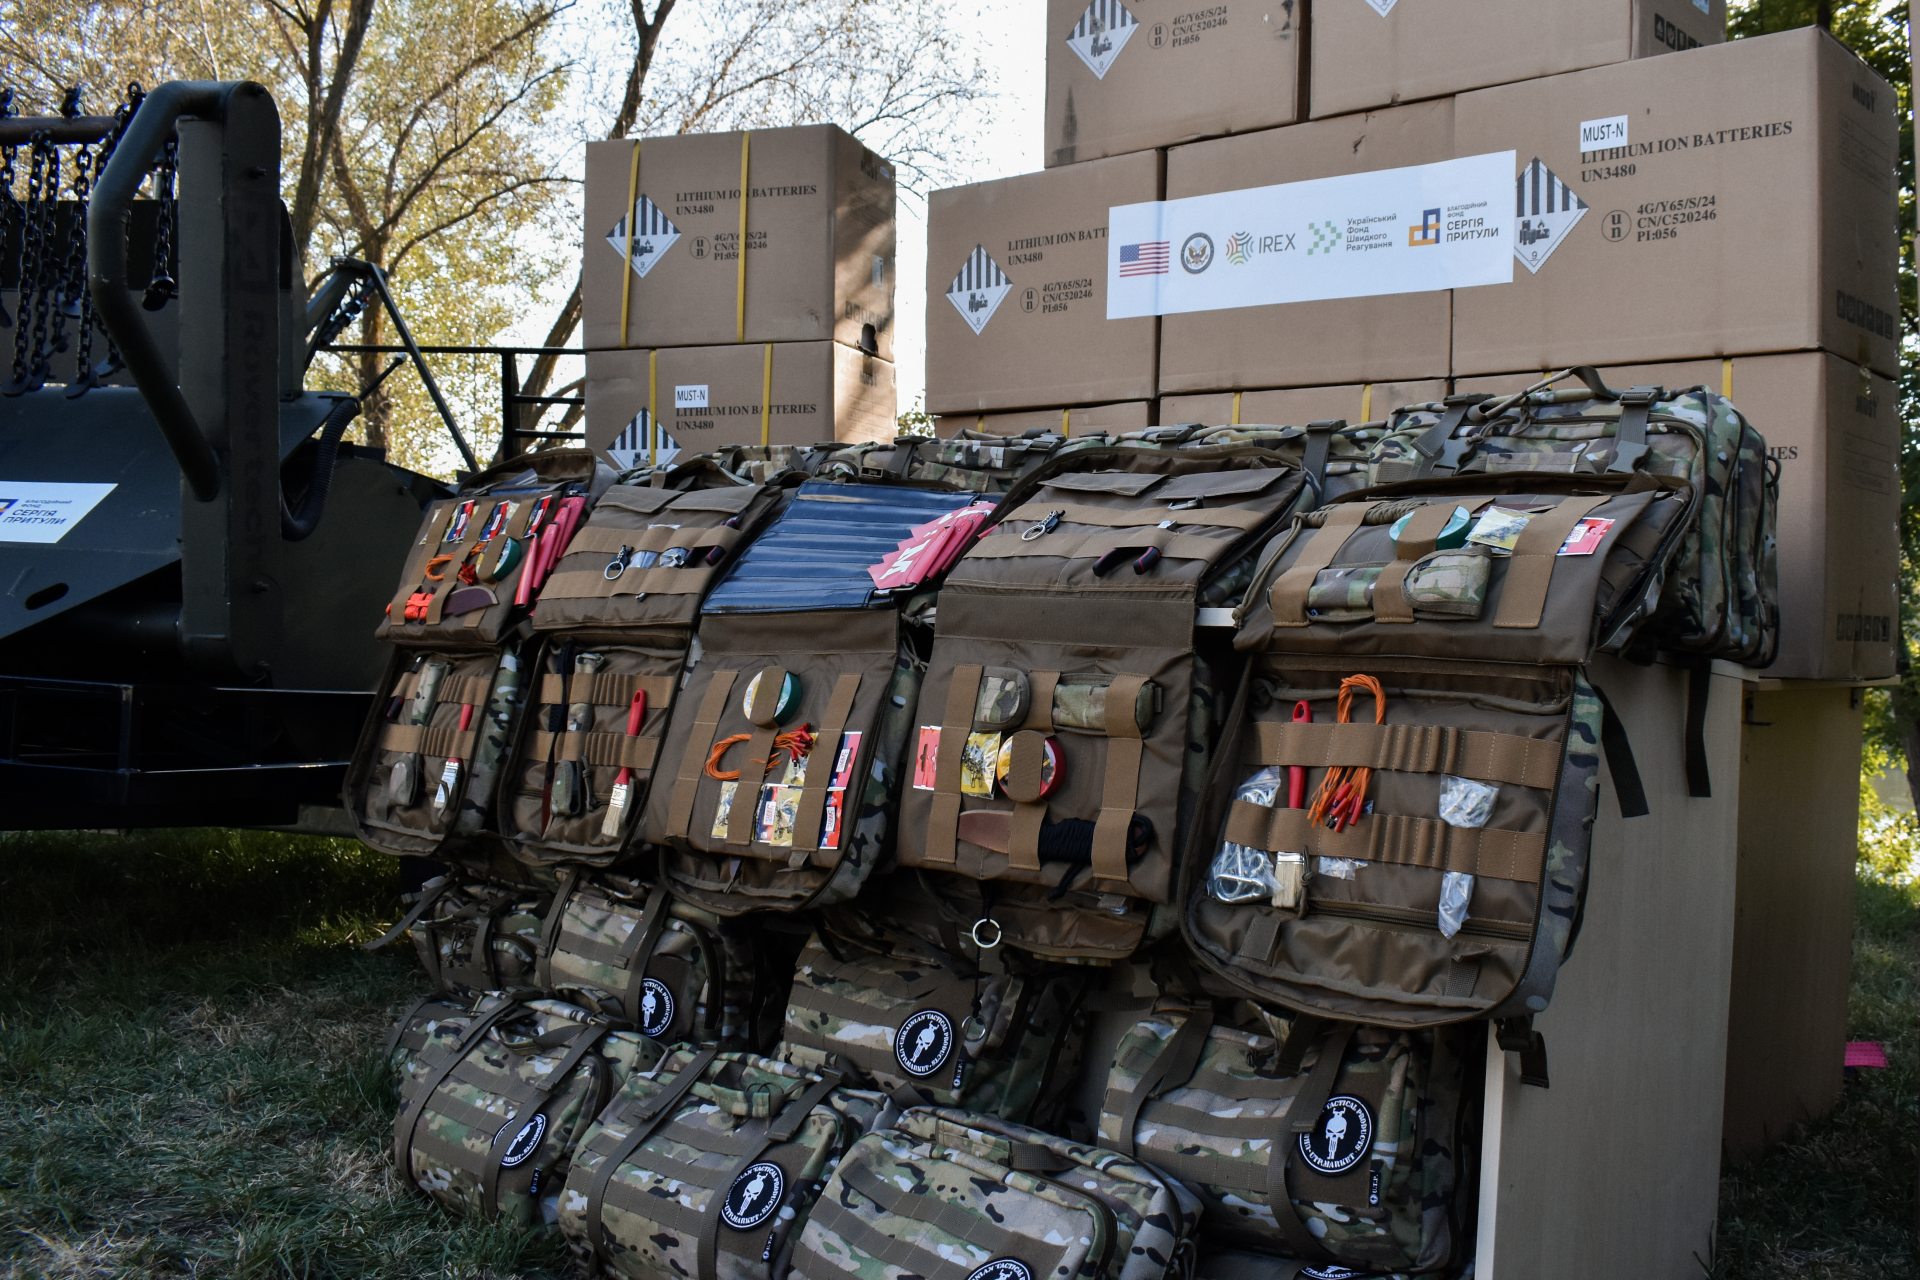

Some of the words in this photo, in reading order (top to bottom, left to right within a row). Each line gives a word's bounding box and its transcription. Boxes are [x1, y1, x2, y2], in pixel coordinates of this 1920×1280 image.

[1172, 5, 1228, 26] 4G/Y65/S/24
[1172, 33, 1200, 48] PI:056
[1582, 122, 1625, 143] MUST-N
[1581, 142, 1654, 165] LITHIUM
[1657, 136, 1689, 153] ION
[1693, 121, 1793, 148] BATTERIES
[1581, 163, 1637, 183] UN3480
[676, 190, 726, 202] LITHIUM
[728, 188, 749, 200] IO
[752, 185, 817, 199] BATTERIES
[676, 205, 714, 216] UN3480
[1637, 195, 1716, 215] 4G/Y65/S/24
[1347, 213, 1397, 226] Український
[1447, 217, 1484, 231] СЕРГІЯ
[1637, 209, 1717, 229] CN/C520246
[714, 231, 767, 241] 4G/Y/S/24
[1346, 226, 1369, 234] Фонд
[1446, 227, 1499, 243] ПРИТУЛИ
[1636, 229, 1678, 243] PI:056
[1008, 235, 1054, 251] LITHIUM
[1056, 231, 1076, 244] ION
[1078, 227, 1109, 241] BATT
[1259, 232, 1296, 254] IREX
[1346, 233, 1387, 243] Швидкого
[714, 241, 767, 252] CN/C0246
[1346, 241, 1393, 252] Реагування
[1008, 252, 1043, 266] UN3480
[1042, 279, 1092, 293] 4G/Y65/S/24
[1042, 289, 1093, 304] CN/C520246
[1042, 303, 1068, 314] PI:056
[677, 389, 706, 401] MUST-N
[676, 406, 726, 417] LITHIUM
[729, 405, 749, 416] ION
[676, 420, 714, 431] UN3480
[12, 509, 58, 517] СЕРГІЯ
[2, 516, 67, 525] ПРИТУЛИ
[1354, 1108, 1367, 1151] PRODUCTS
